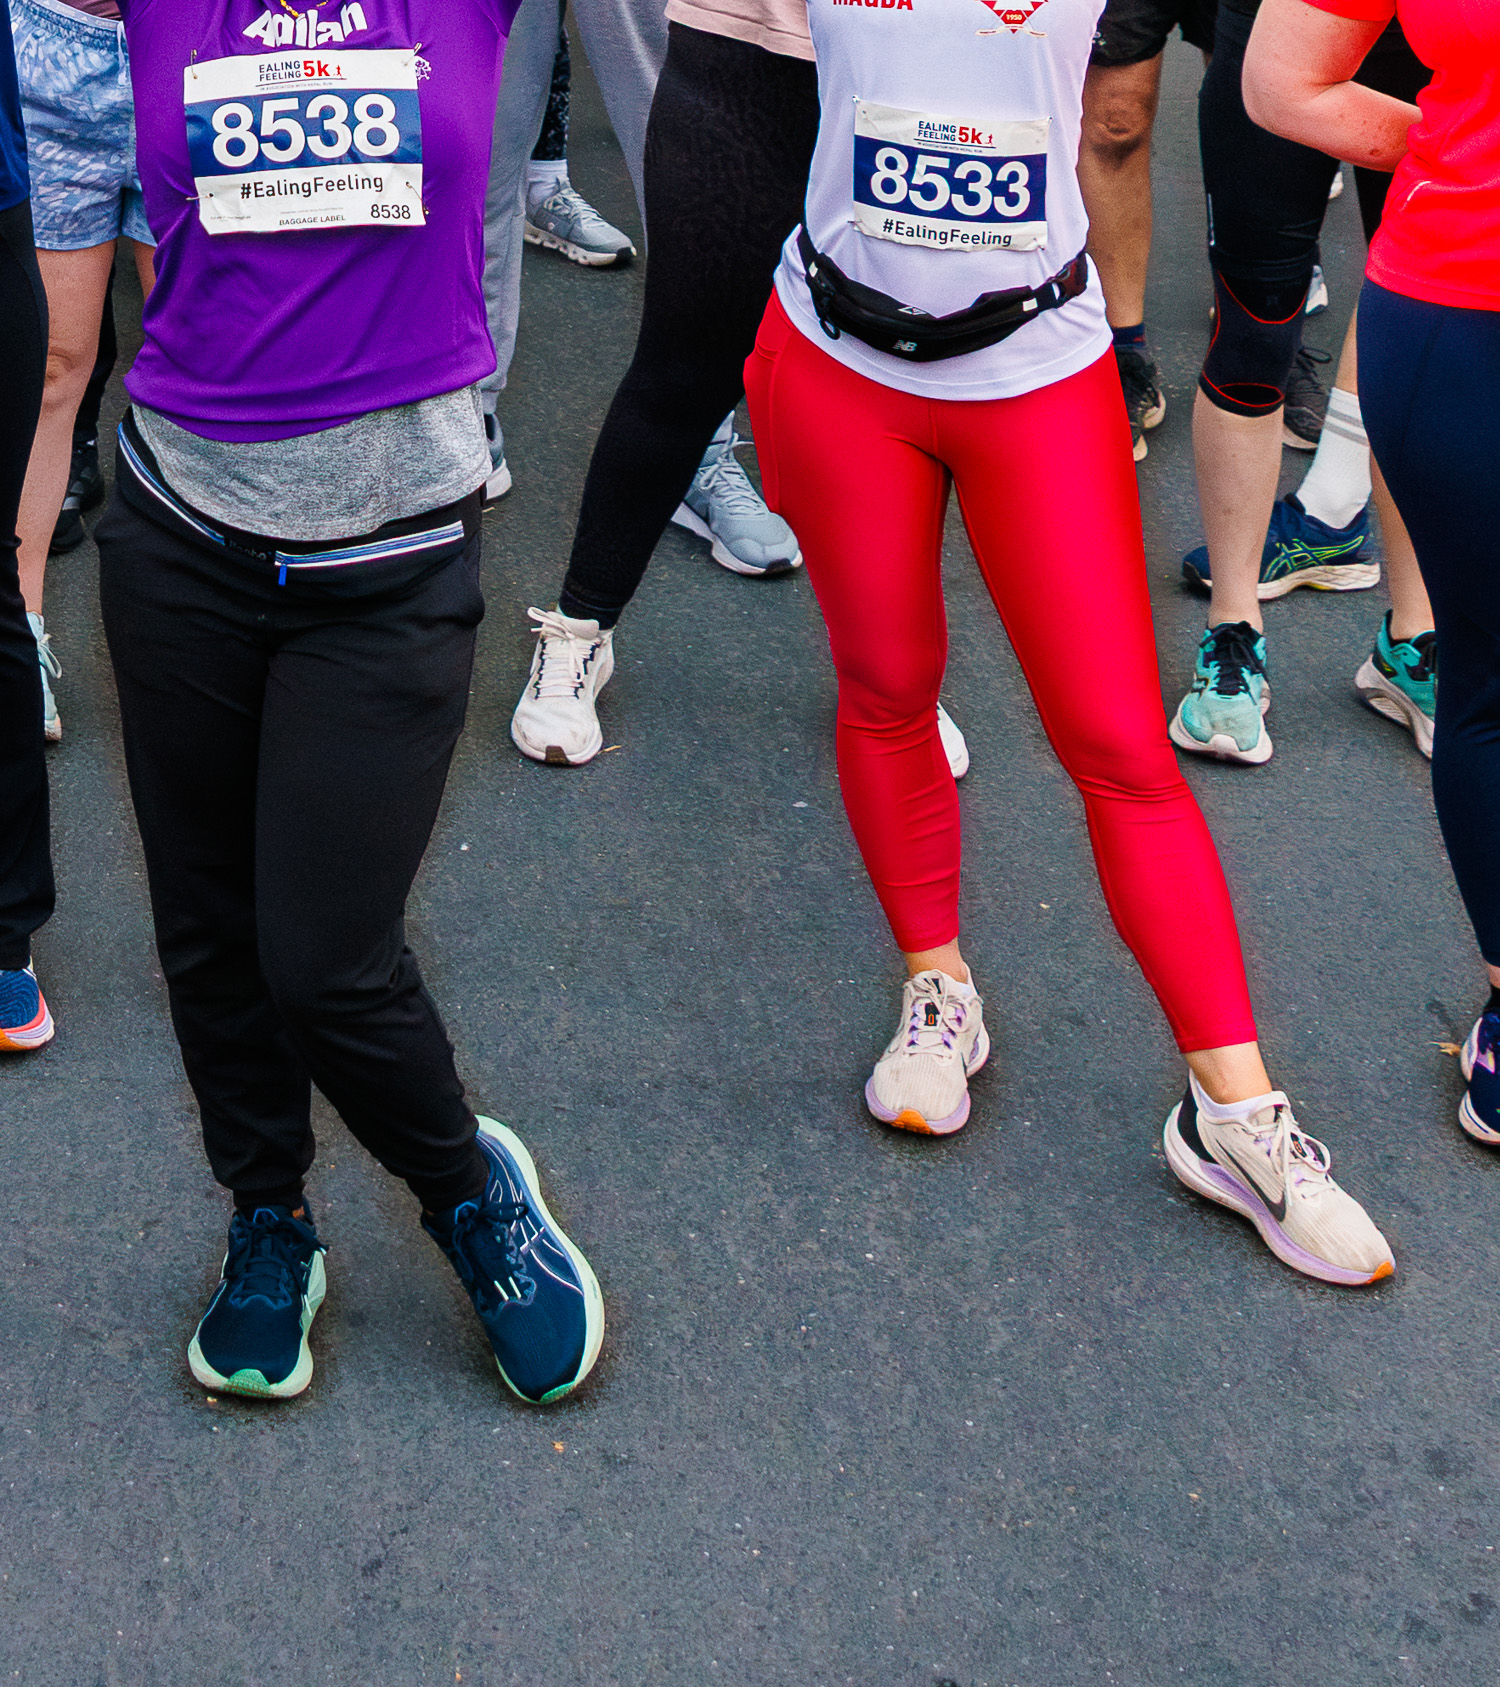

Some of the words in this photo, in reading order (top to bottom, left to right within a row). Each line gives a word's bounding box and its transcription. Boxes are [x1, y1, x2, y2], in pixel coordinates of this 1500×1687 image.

[259, 61, 301, 73] EALING
[303, 60, 331, 77] 5k
[259, 70, 302, 82] FEELING
[211, 93, 400, 168] 8538
[918, 120, 957, 133] EALING
[917, 129, 956, 142] FEELING
[958, 126, 983, 144] 5k
[240, 175, 383, 199] #EalingFeeling
[870, 147, 1031, 217] 8533
[370, 204, 411, 220] 8538
[279, 216, 318, 226] BAGGAGE
[320, 215, 346, 223] LABEL
[883, 218, 1012, 248] #EalingFeeling
